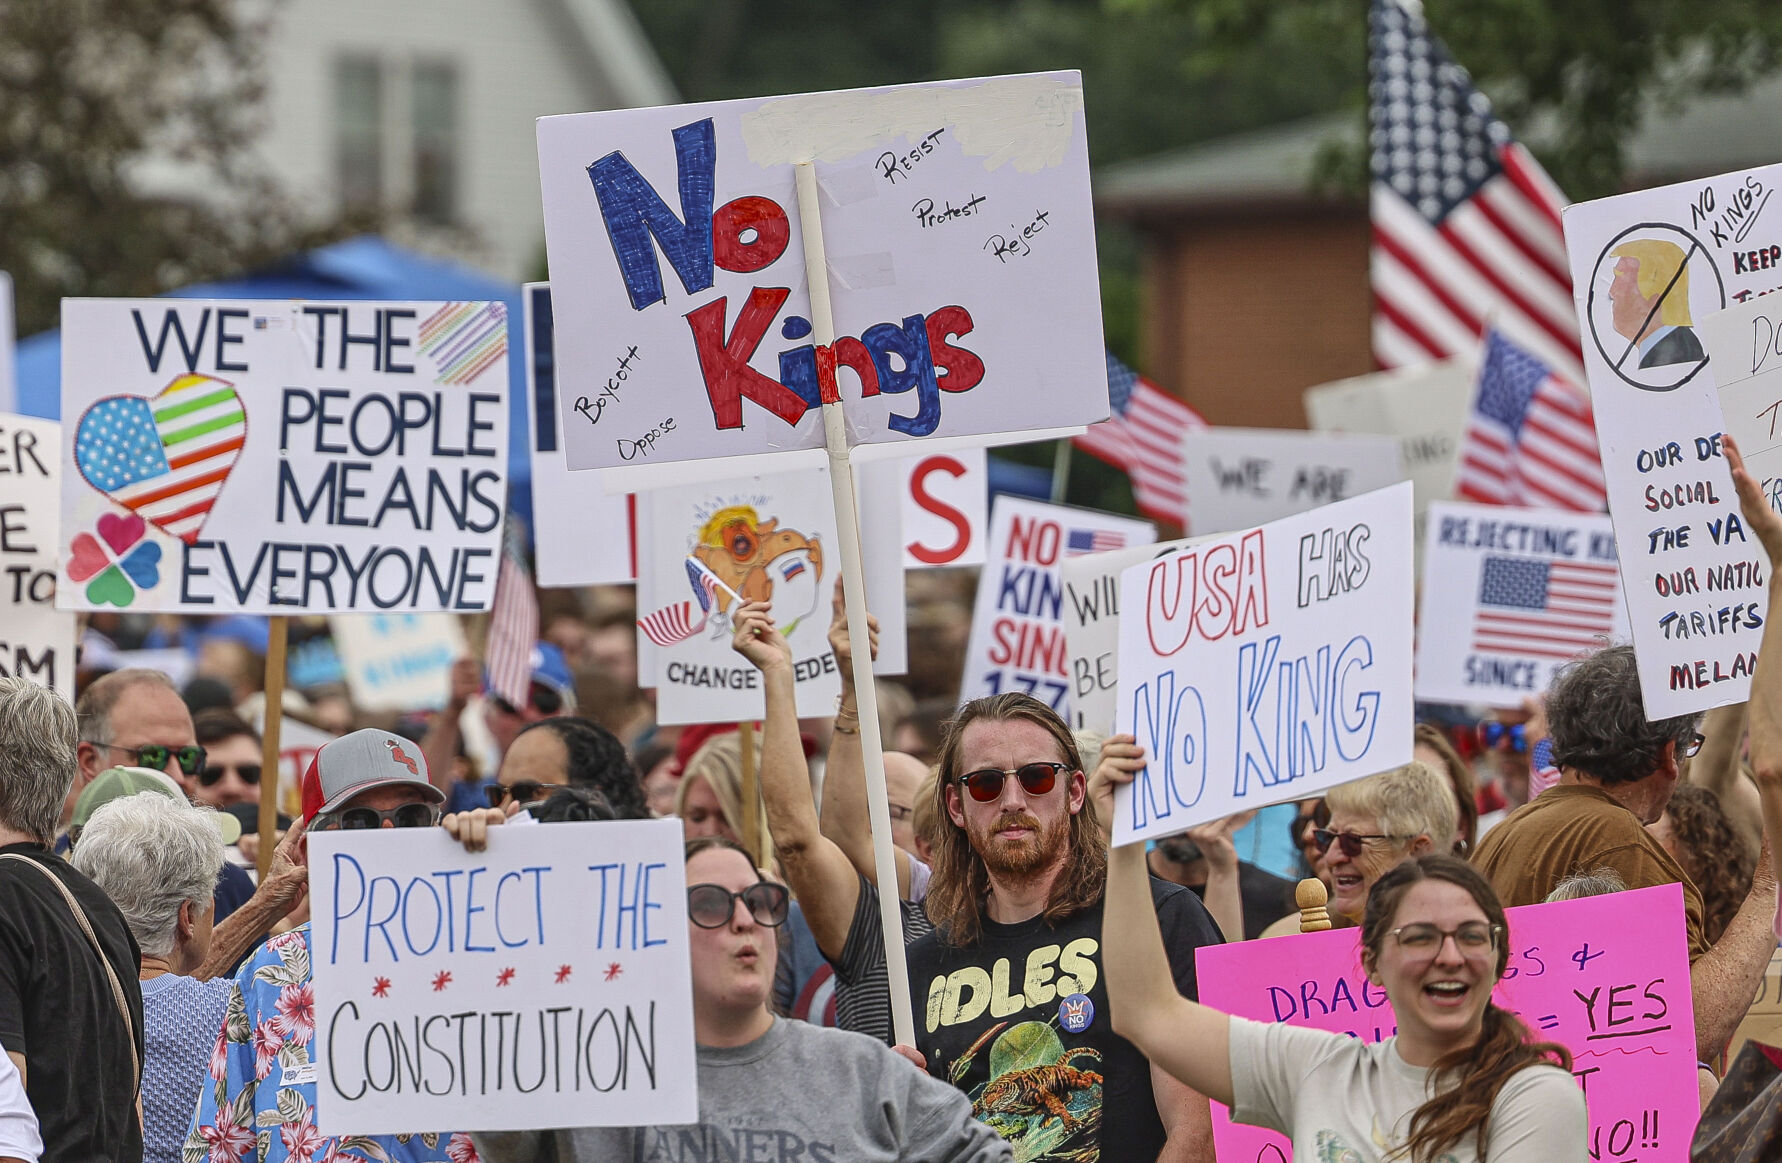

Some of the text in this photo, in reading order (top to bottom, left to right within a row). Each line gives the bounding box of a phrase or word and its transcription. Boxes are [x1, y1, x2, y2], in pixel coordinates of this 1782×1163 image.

[585, 116, 792, 312] No
[912, 196, 987, 228] Protest
[983, 208, 1050, 263] Reject
[1690, 186, 1716, 230] NO
[1709, 175, 1763, 248] KINGS
[1732, 244, 1782, 275] KEEP
[131, 306, 416, 374] WE THE
[681, 286, 986, 438] Kings
[573, 344, 641, 425] Boycott
[279, 387, 501, 457] PEOPLE
[616, 416, 678, 461] Oppose
[1207, 455, 1353, 501] WE ARE
[1636, 431, 1725, 474] OUR DE
[276, 458, 501, 534] MEANS
[1644, 480, 1721, 512] SOCIAL
[1004, 513, 1062, 567] NO
[1438, 515, 1579, 557] REJECTING
[1647, 512, 1747, 555] THE VA
[179, 541, 494, 611] EVERYONE
[1146, 523, 1371, 658] USA HAS
[1655, 566, 1700, 598] OUR
[667, 661, 759, 690] CHANGE
[1463, 655, 1537, 689] SINCE
[1132, 634, 1381, 831] NO KING
[330, 852, 668, 965] PROTECT THE
[925, 937, 1099, 1034] IDLES
[1573, 978, 1668, 1033] YES
[1068, 1015, 1084, 1025] NO
[327, 999, 657, 1101] CONSTITUTION
